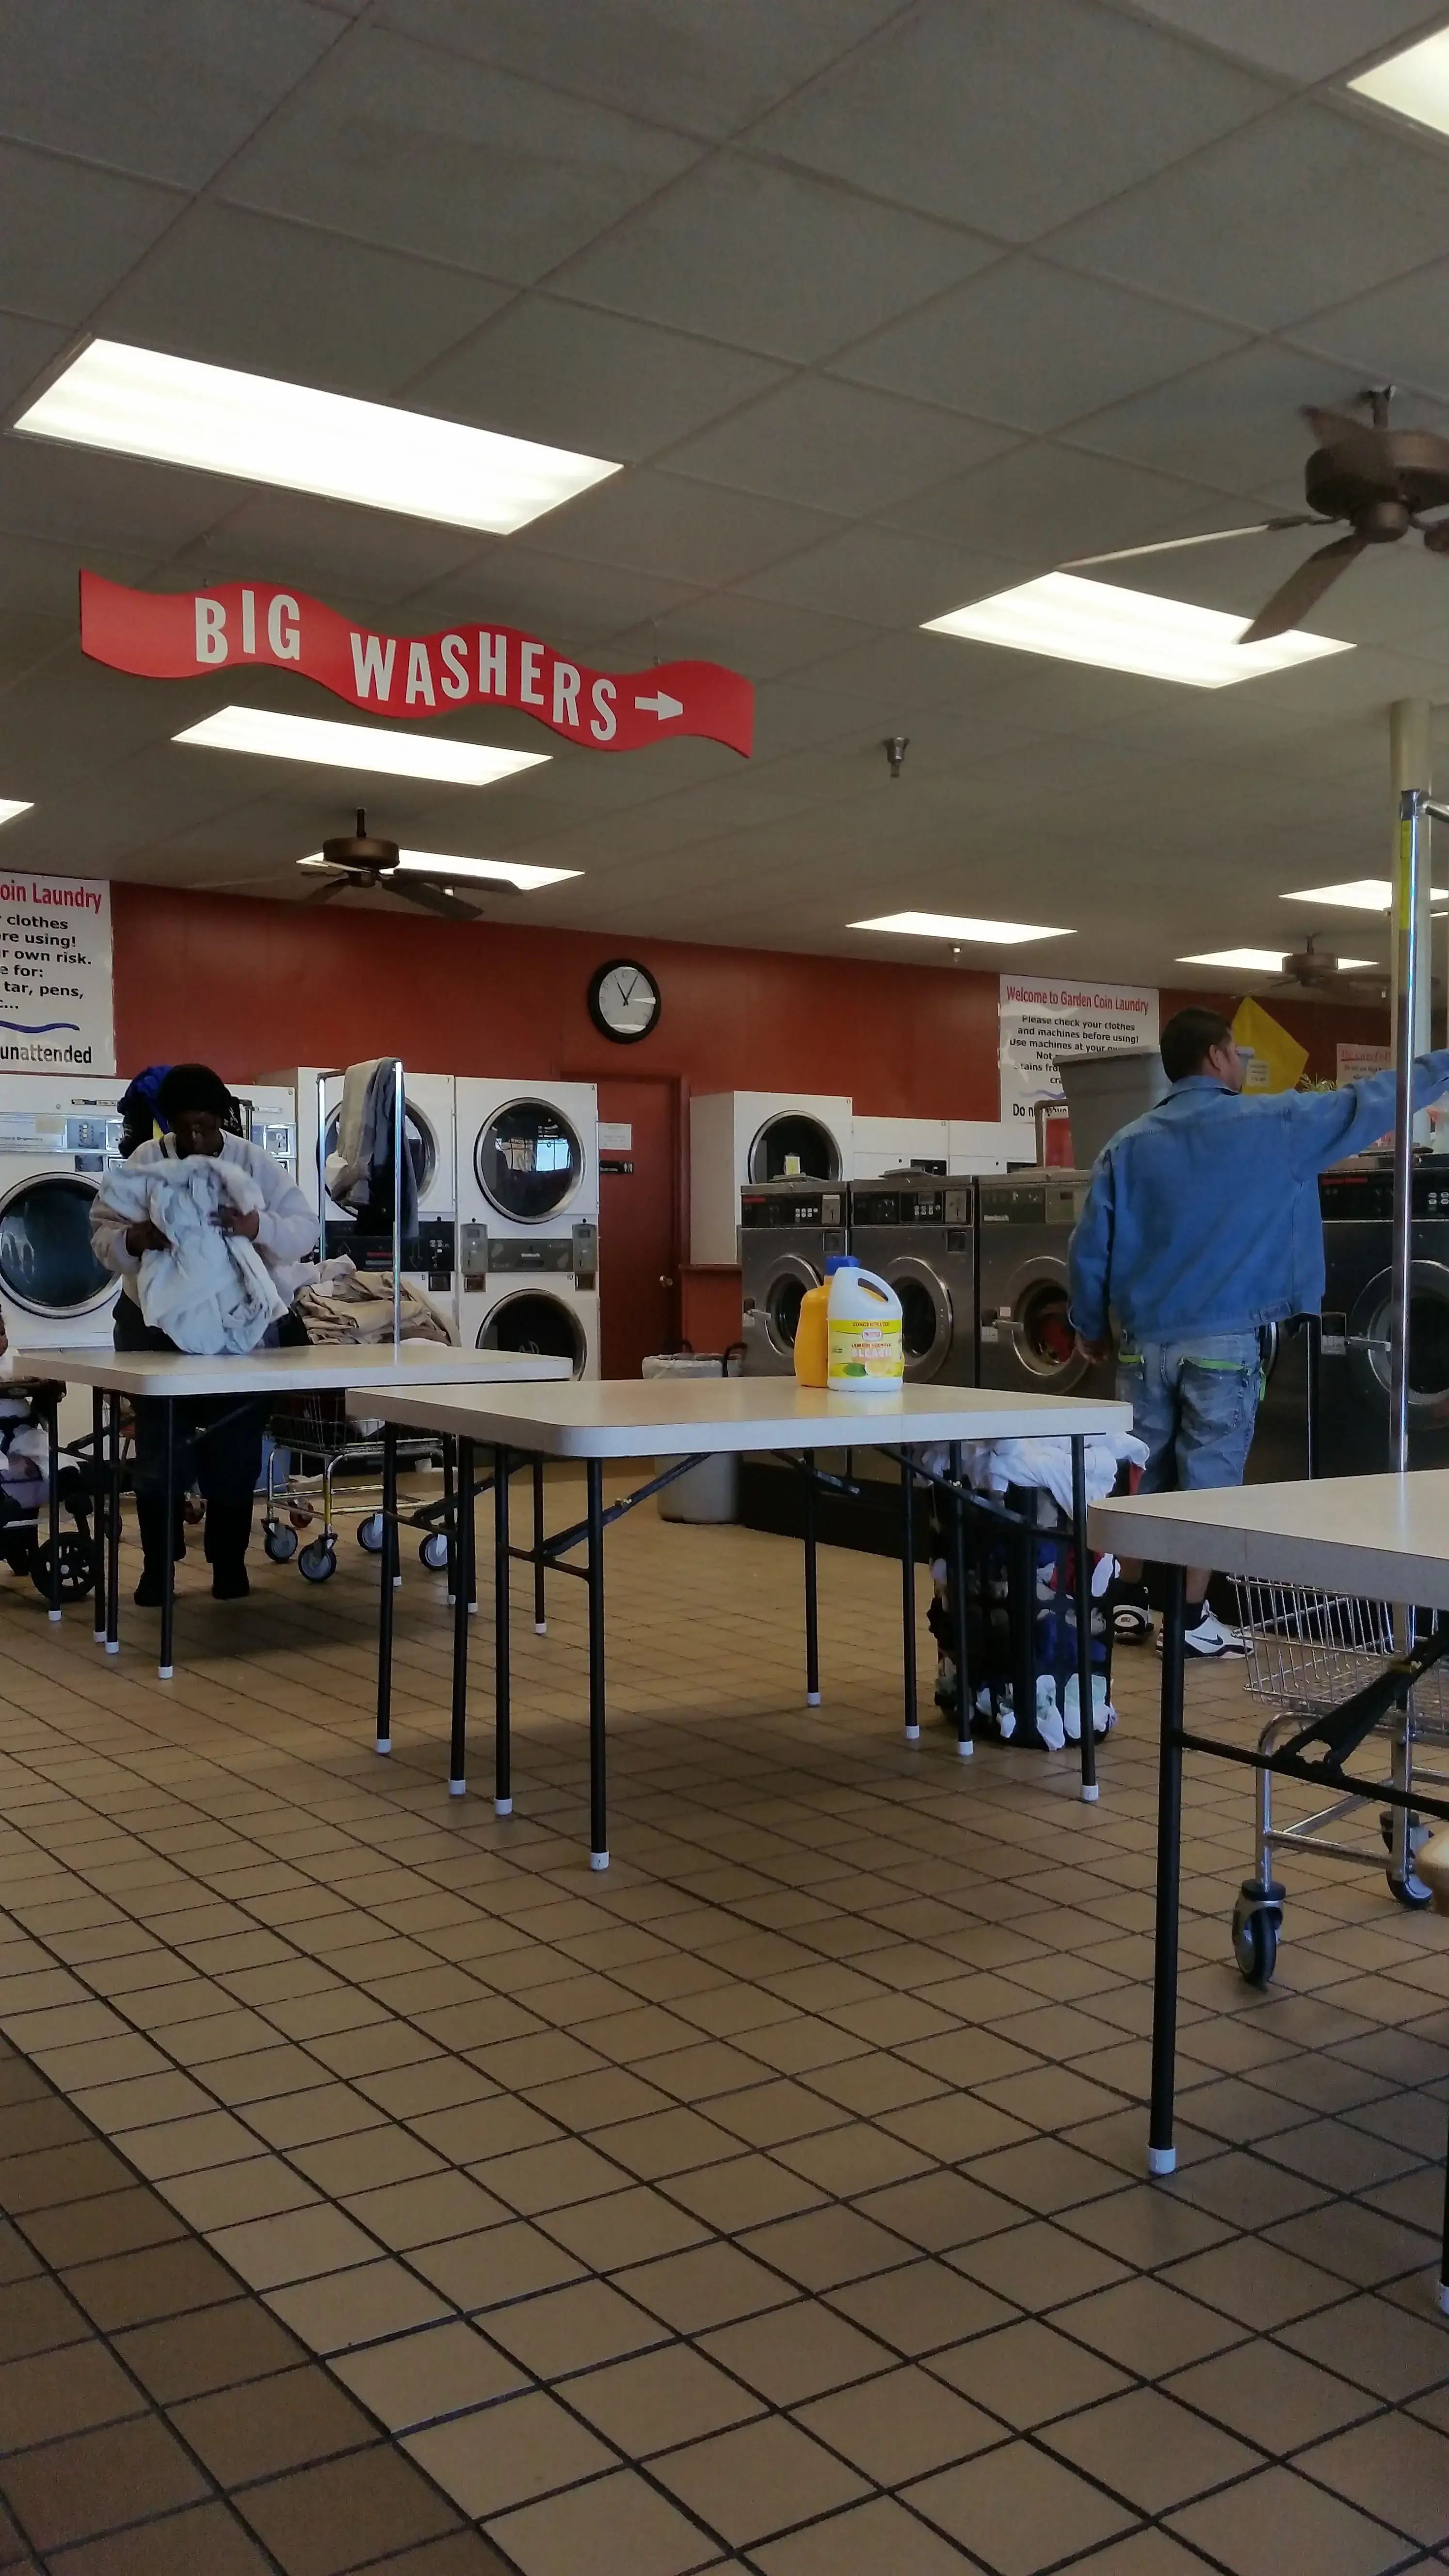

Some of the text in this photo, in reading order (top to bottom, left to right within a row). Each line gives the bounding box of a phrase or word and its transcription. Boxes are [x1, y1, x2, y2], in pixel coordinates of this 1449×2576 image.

[195, 589, 617, 741] BIG WASHERS
[32, 882, 102, 915] Laundry
[6, 914, 68, 930] clothes
[0, 932, 76, 949] re using!
[14, 950, 50, 962] own
[56, 951, 92, 965] risk.
[14, 964, 43, 978] for:
[4, 981, 83, 999] tar, pens,
[1006, 985, 1149, 1016] Welcome to Garden Coin Laundry
[1022, 1014, 1135, 1031] Please check your clothes
[1029, 1040, 1072, 1049] machines
[1037, 1029, 1080, 1038] machines
[1082, 1031, 1111, 1041] before
[1113, 1035, 1139, 1044] using!
[0, 1044, 92, 1064] unattended
[1036, 1051, 1052, 1060] Not
[1045, 1063, 1061, 1072] fro
[1013, 1103, 1026, 1116] Do
